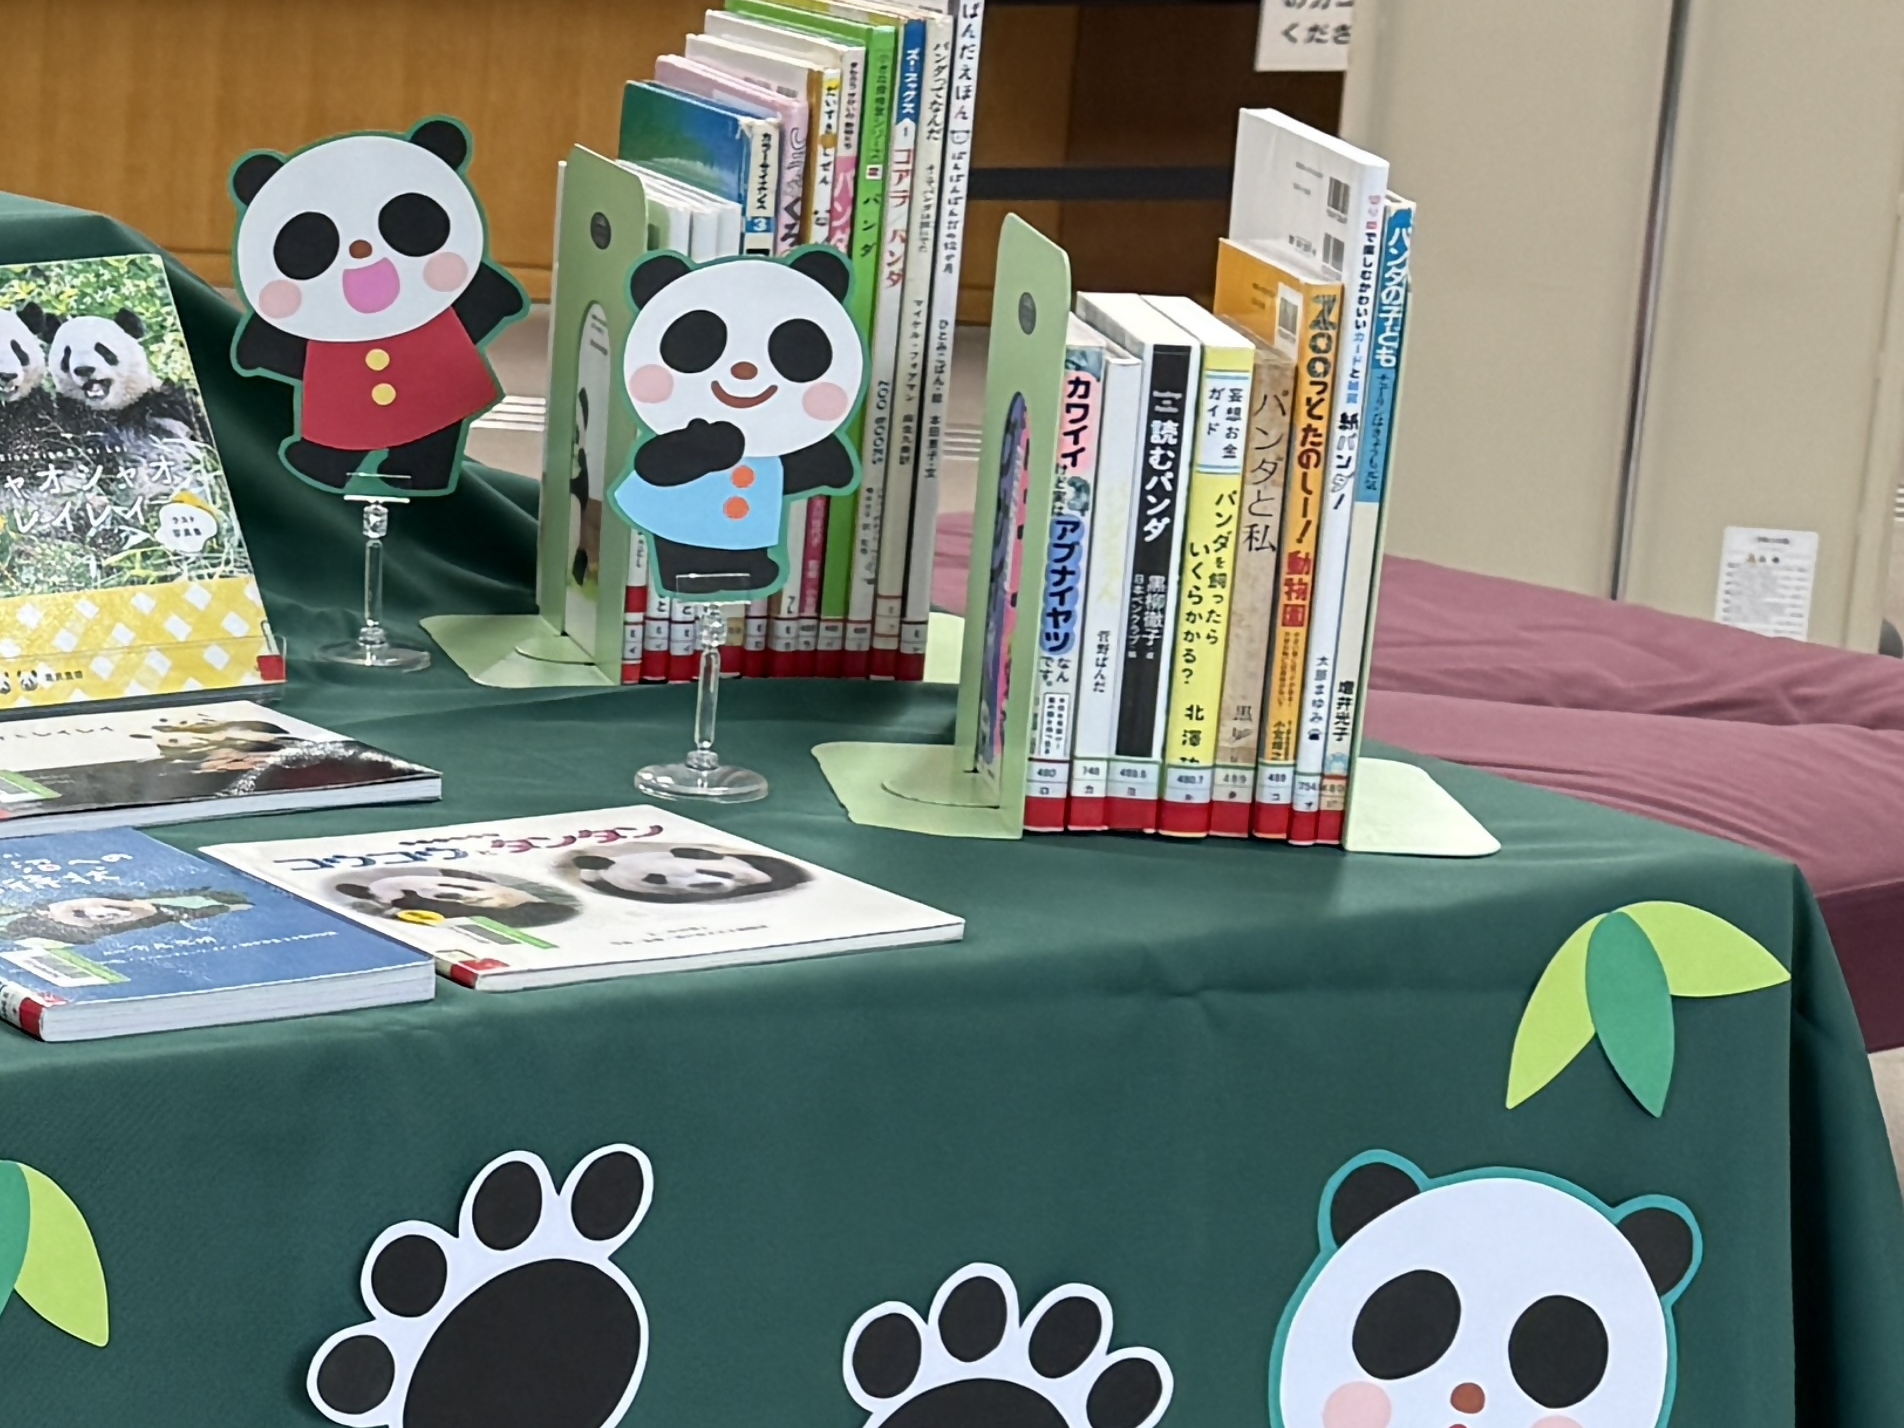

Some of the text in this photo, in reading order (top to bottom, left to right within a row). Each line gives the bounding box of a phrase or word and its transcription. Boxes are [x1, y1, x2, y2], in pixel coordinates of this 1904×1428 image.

[953, 1, 981, 122] ぱんだえほん
[859, 194, 881, 259] パンダ
[890, 147, 914, 209] コアラ
[1206, 386, 1225, 436] ガイド
[1222, 386, 1244, 459] 妄想お金
[15, 494, 148, 534] レイレイ
[1044, 376, 1092, 653] カワイイ アブナイヤツ
[1142, 420, 1180, 542] 読むパンダ
[1240, 390, 1291, 553] パンダと私
[1181, 542, 1210, 684] いくらかかる？
[1204, 491, 1237, 645] パンダを飼ったら
[1281, 550, 1312, 628] 動物園
